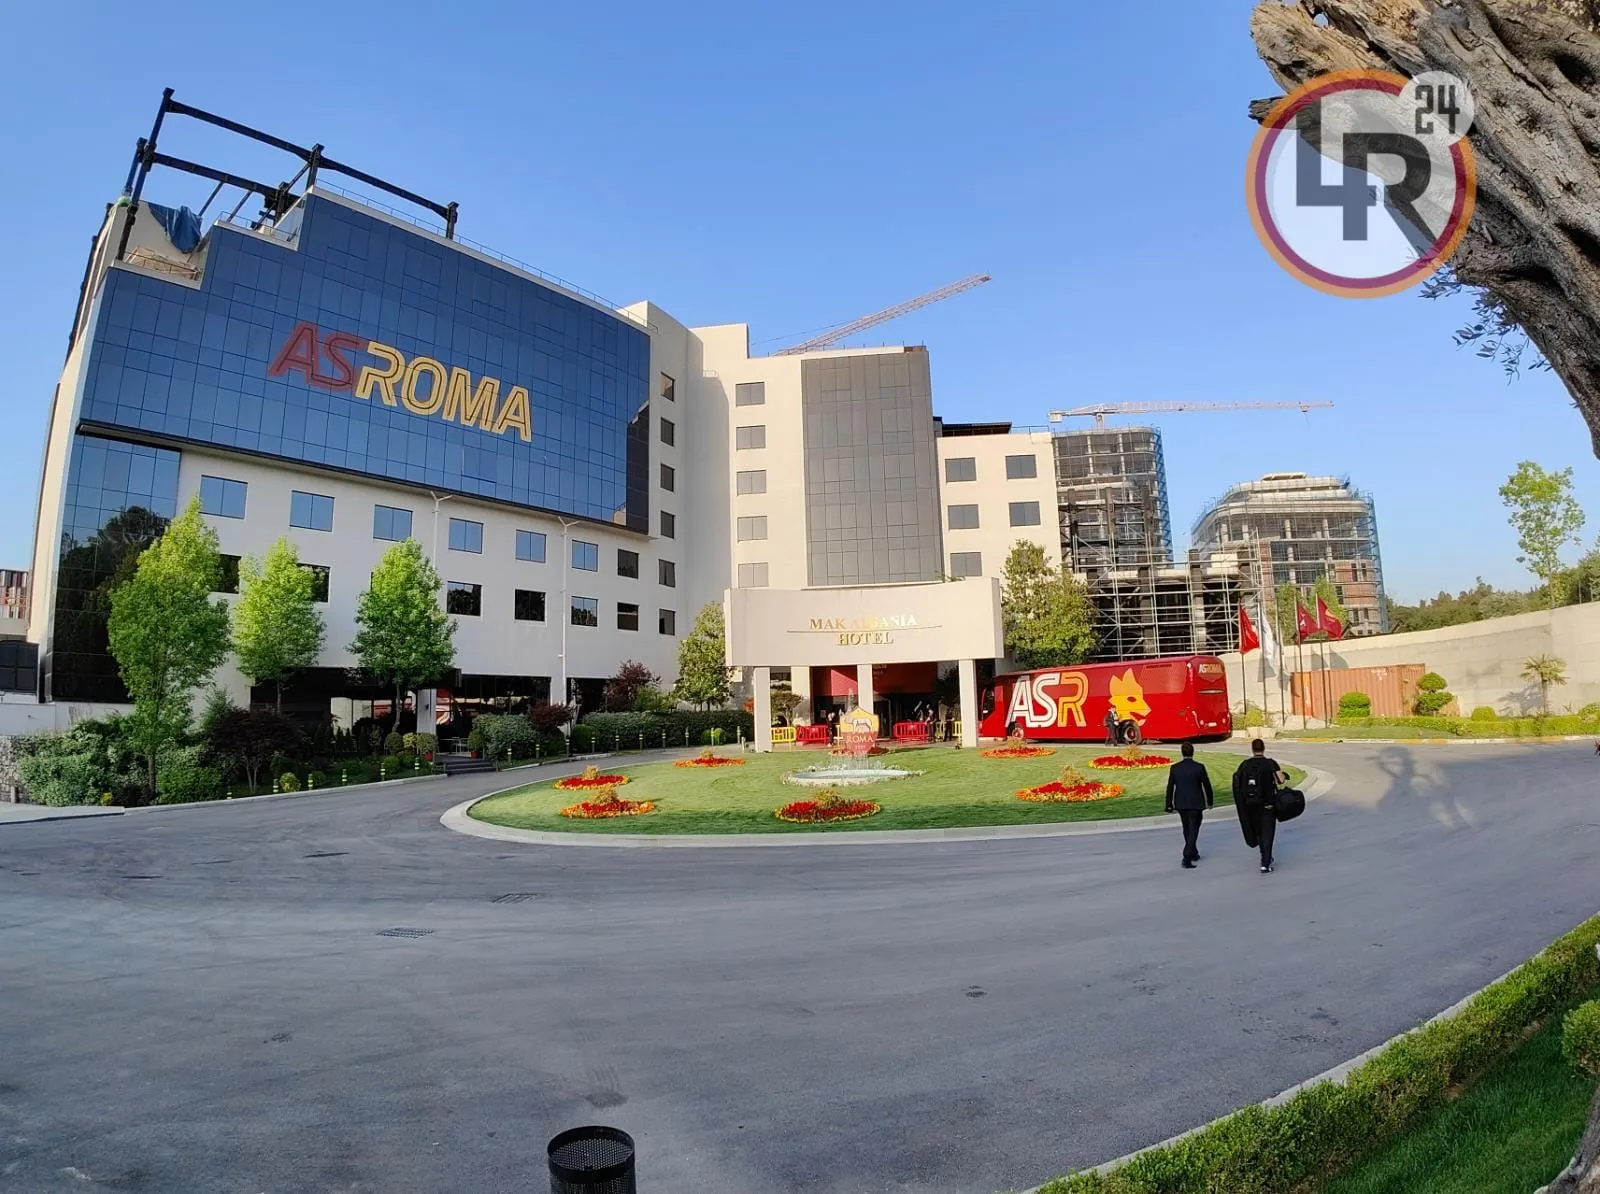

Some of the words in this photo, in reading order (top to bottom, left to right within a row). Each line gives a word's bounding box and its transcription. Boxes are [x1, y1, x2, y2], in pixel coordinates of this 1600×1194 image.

[809, 617, 846, 630] MAK
[838, 632, 895, 646] HOTEL
[1005, 671, 1089, 728] ASR
[845, 735, 874, 743] ROMA
